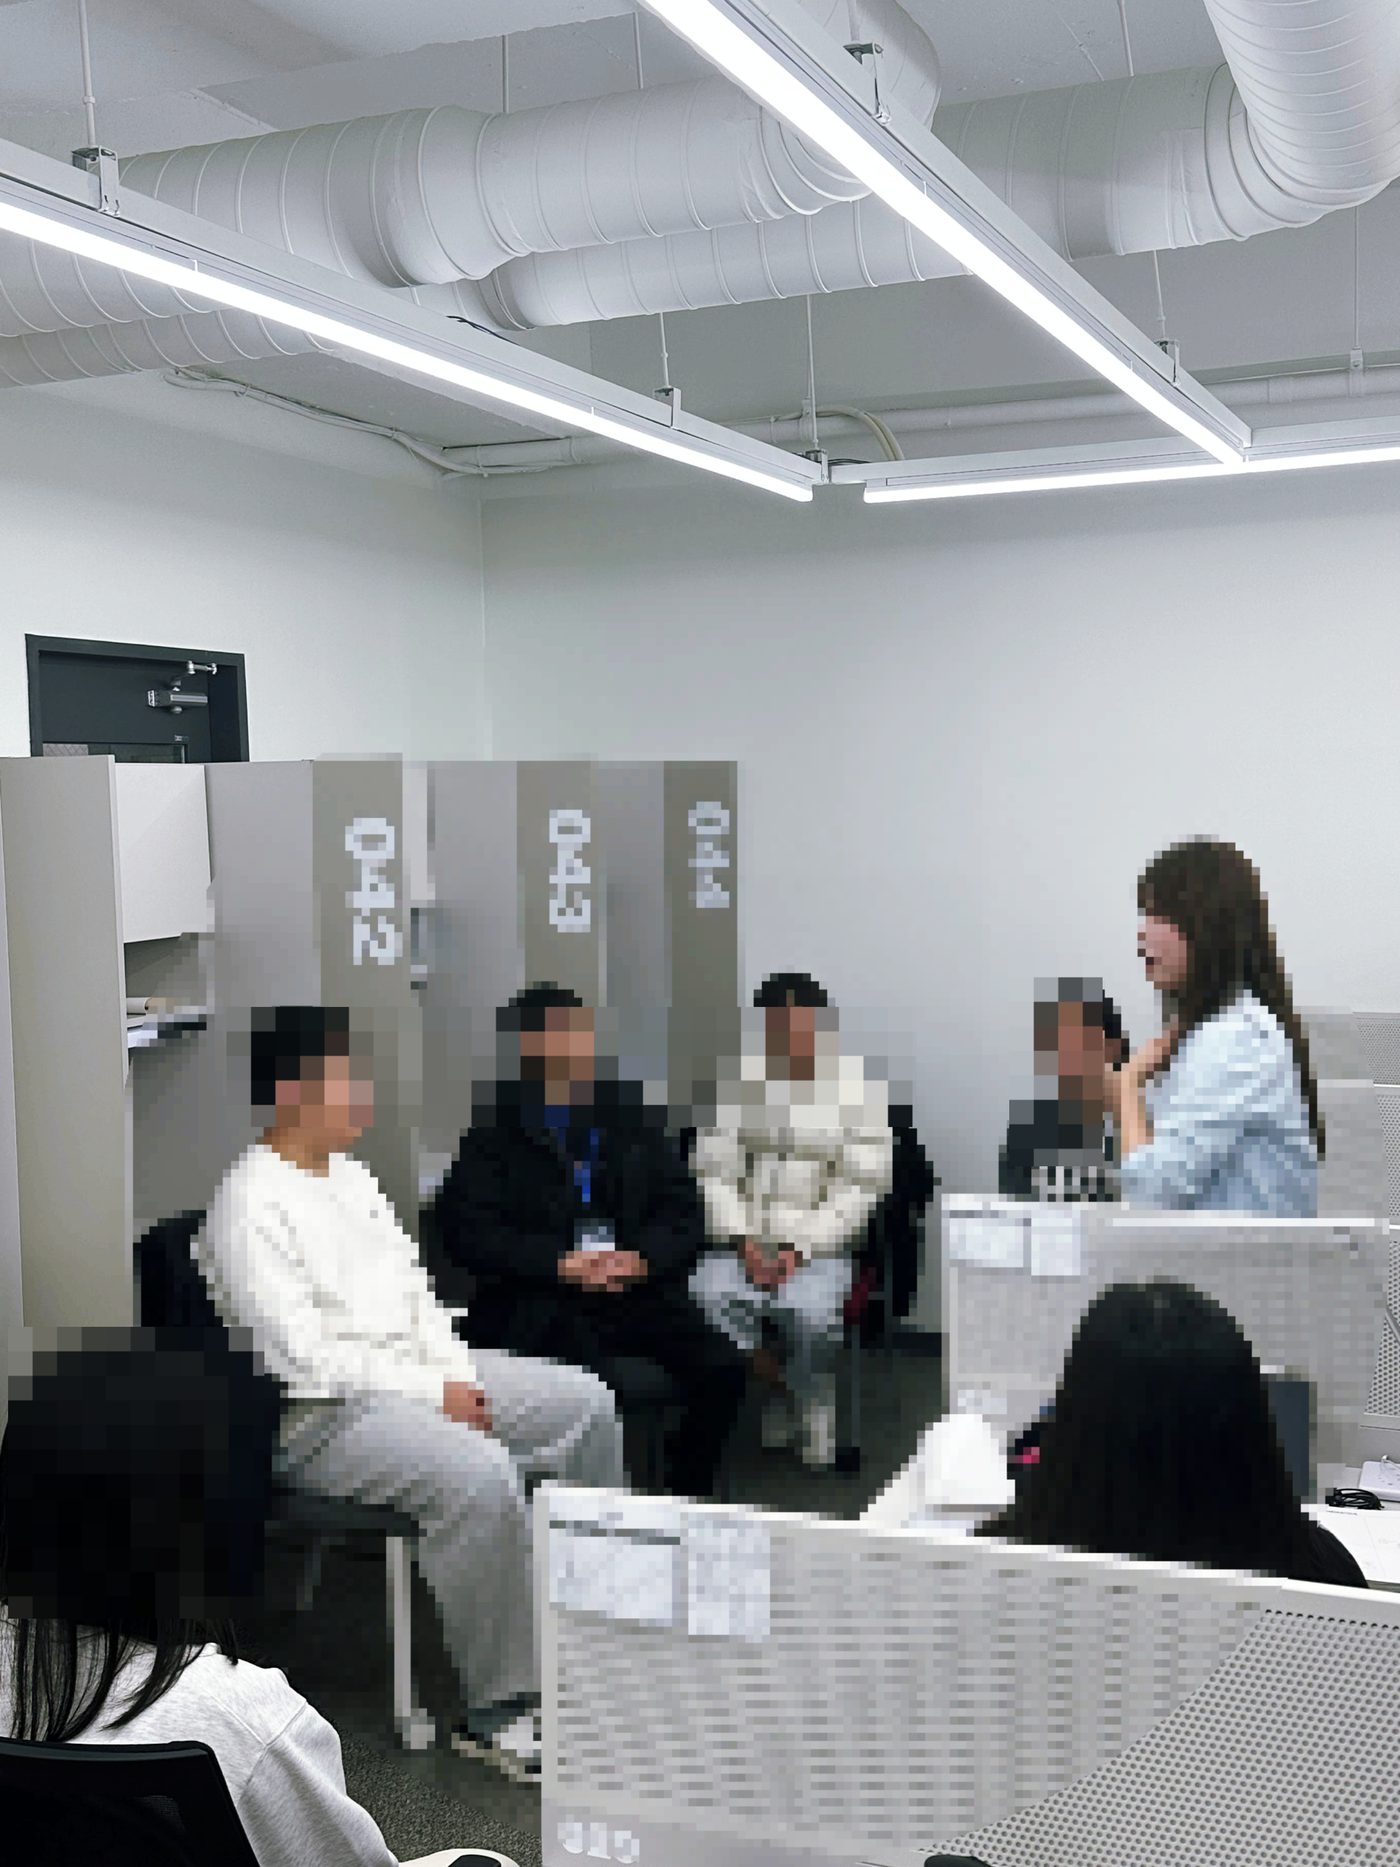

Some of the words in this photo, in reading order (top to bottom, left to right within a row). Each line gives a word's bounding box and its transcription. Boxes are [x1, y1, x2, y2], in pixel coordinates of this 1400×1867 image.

[345, 818, 402, 965] 042
[549, 809, 591, 932] 043
[688, 802, 729, 908] 044
